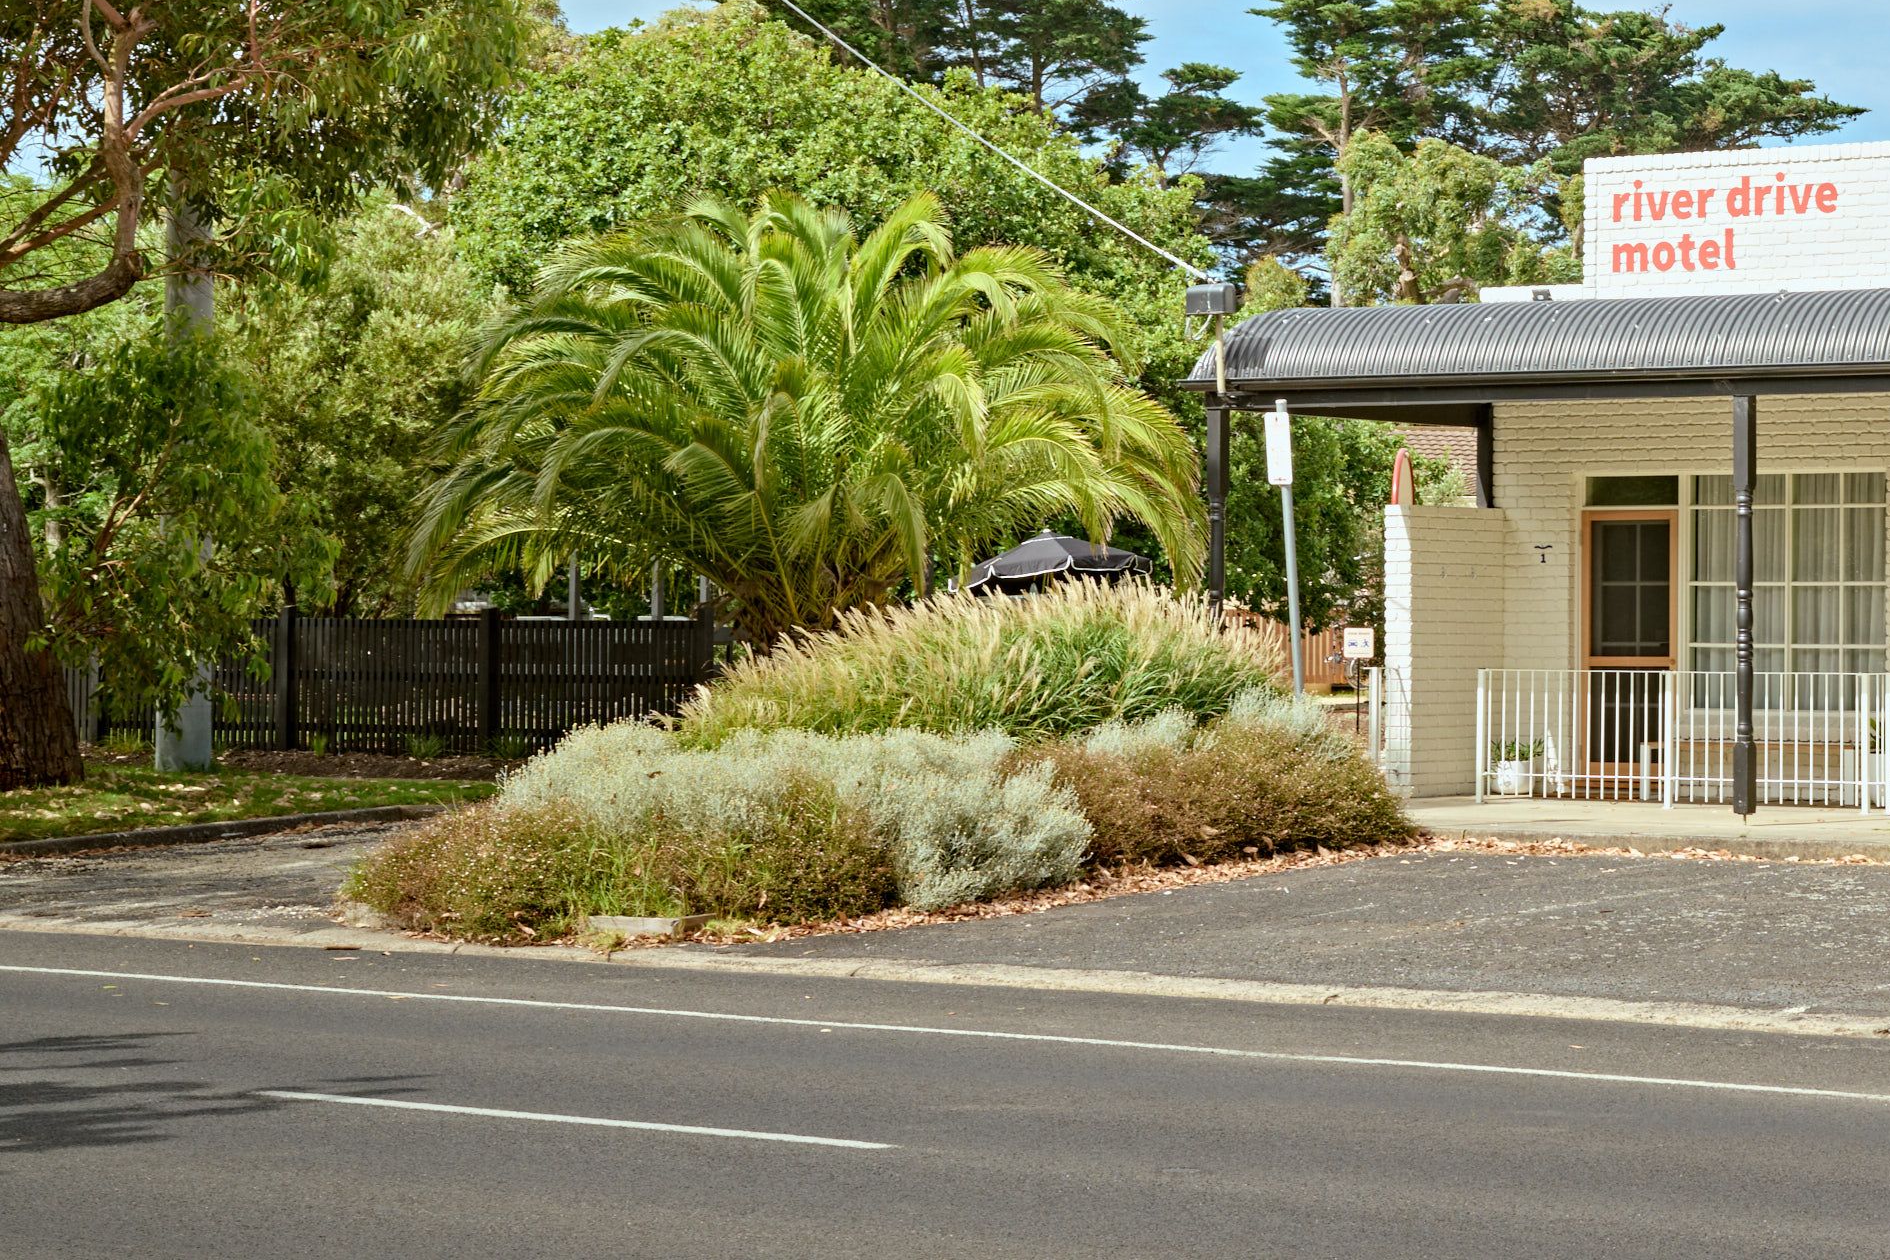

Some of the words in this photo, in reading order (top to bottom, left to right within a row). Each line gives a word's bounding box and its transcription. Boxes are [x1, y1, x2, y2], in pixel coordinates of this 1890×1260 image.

[1612, 180, 1715, 222] river
[1726, 172, 1839, 217] drive
[1612, 228, 1736, 273] motel
[1540, 553, 1547, 564] 1
